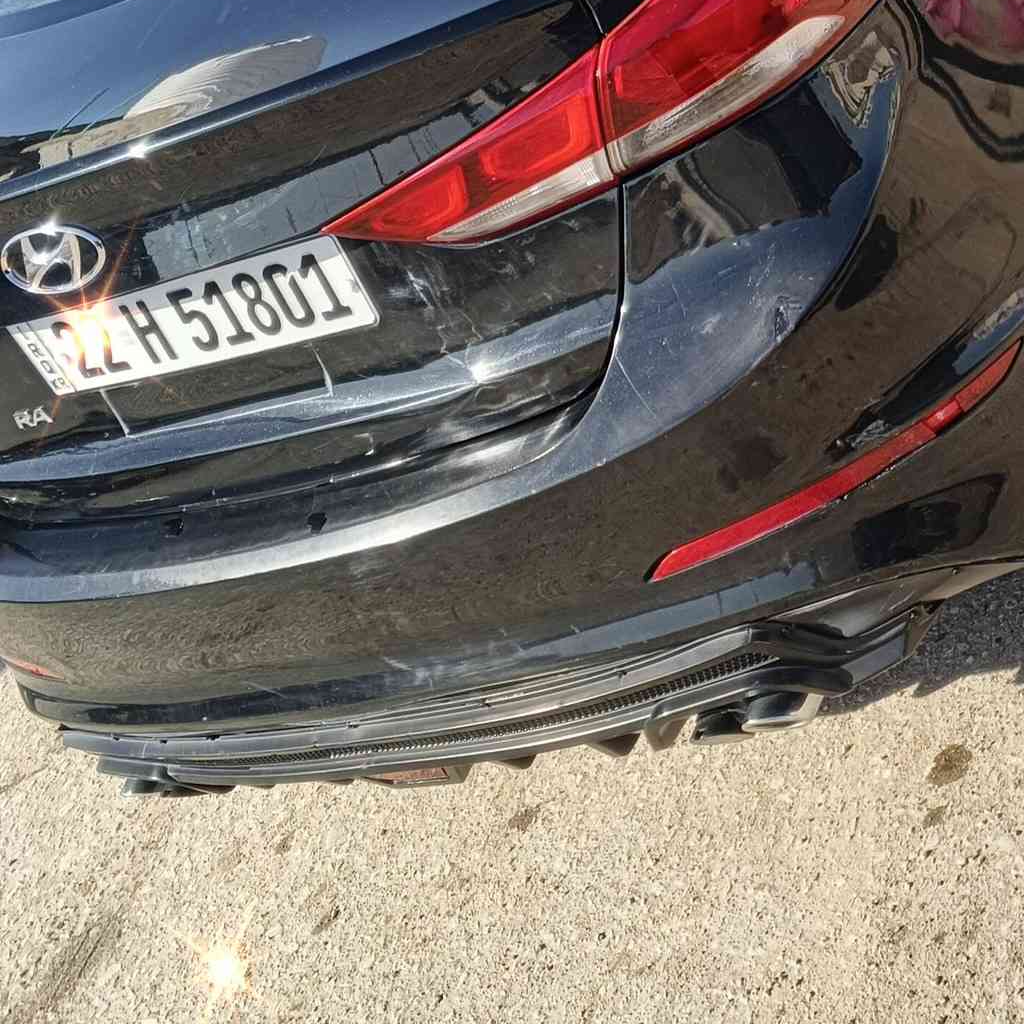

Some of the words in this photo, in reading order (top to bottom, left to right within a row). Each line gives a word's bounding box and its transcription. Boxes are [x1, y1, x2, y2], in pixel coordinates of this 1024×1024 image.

[119, 300, 178, 363] H
[165, 254, 353, 352] 51801
[12, 405, 53, 430] RA
